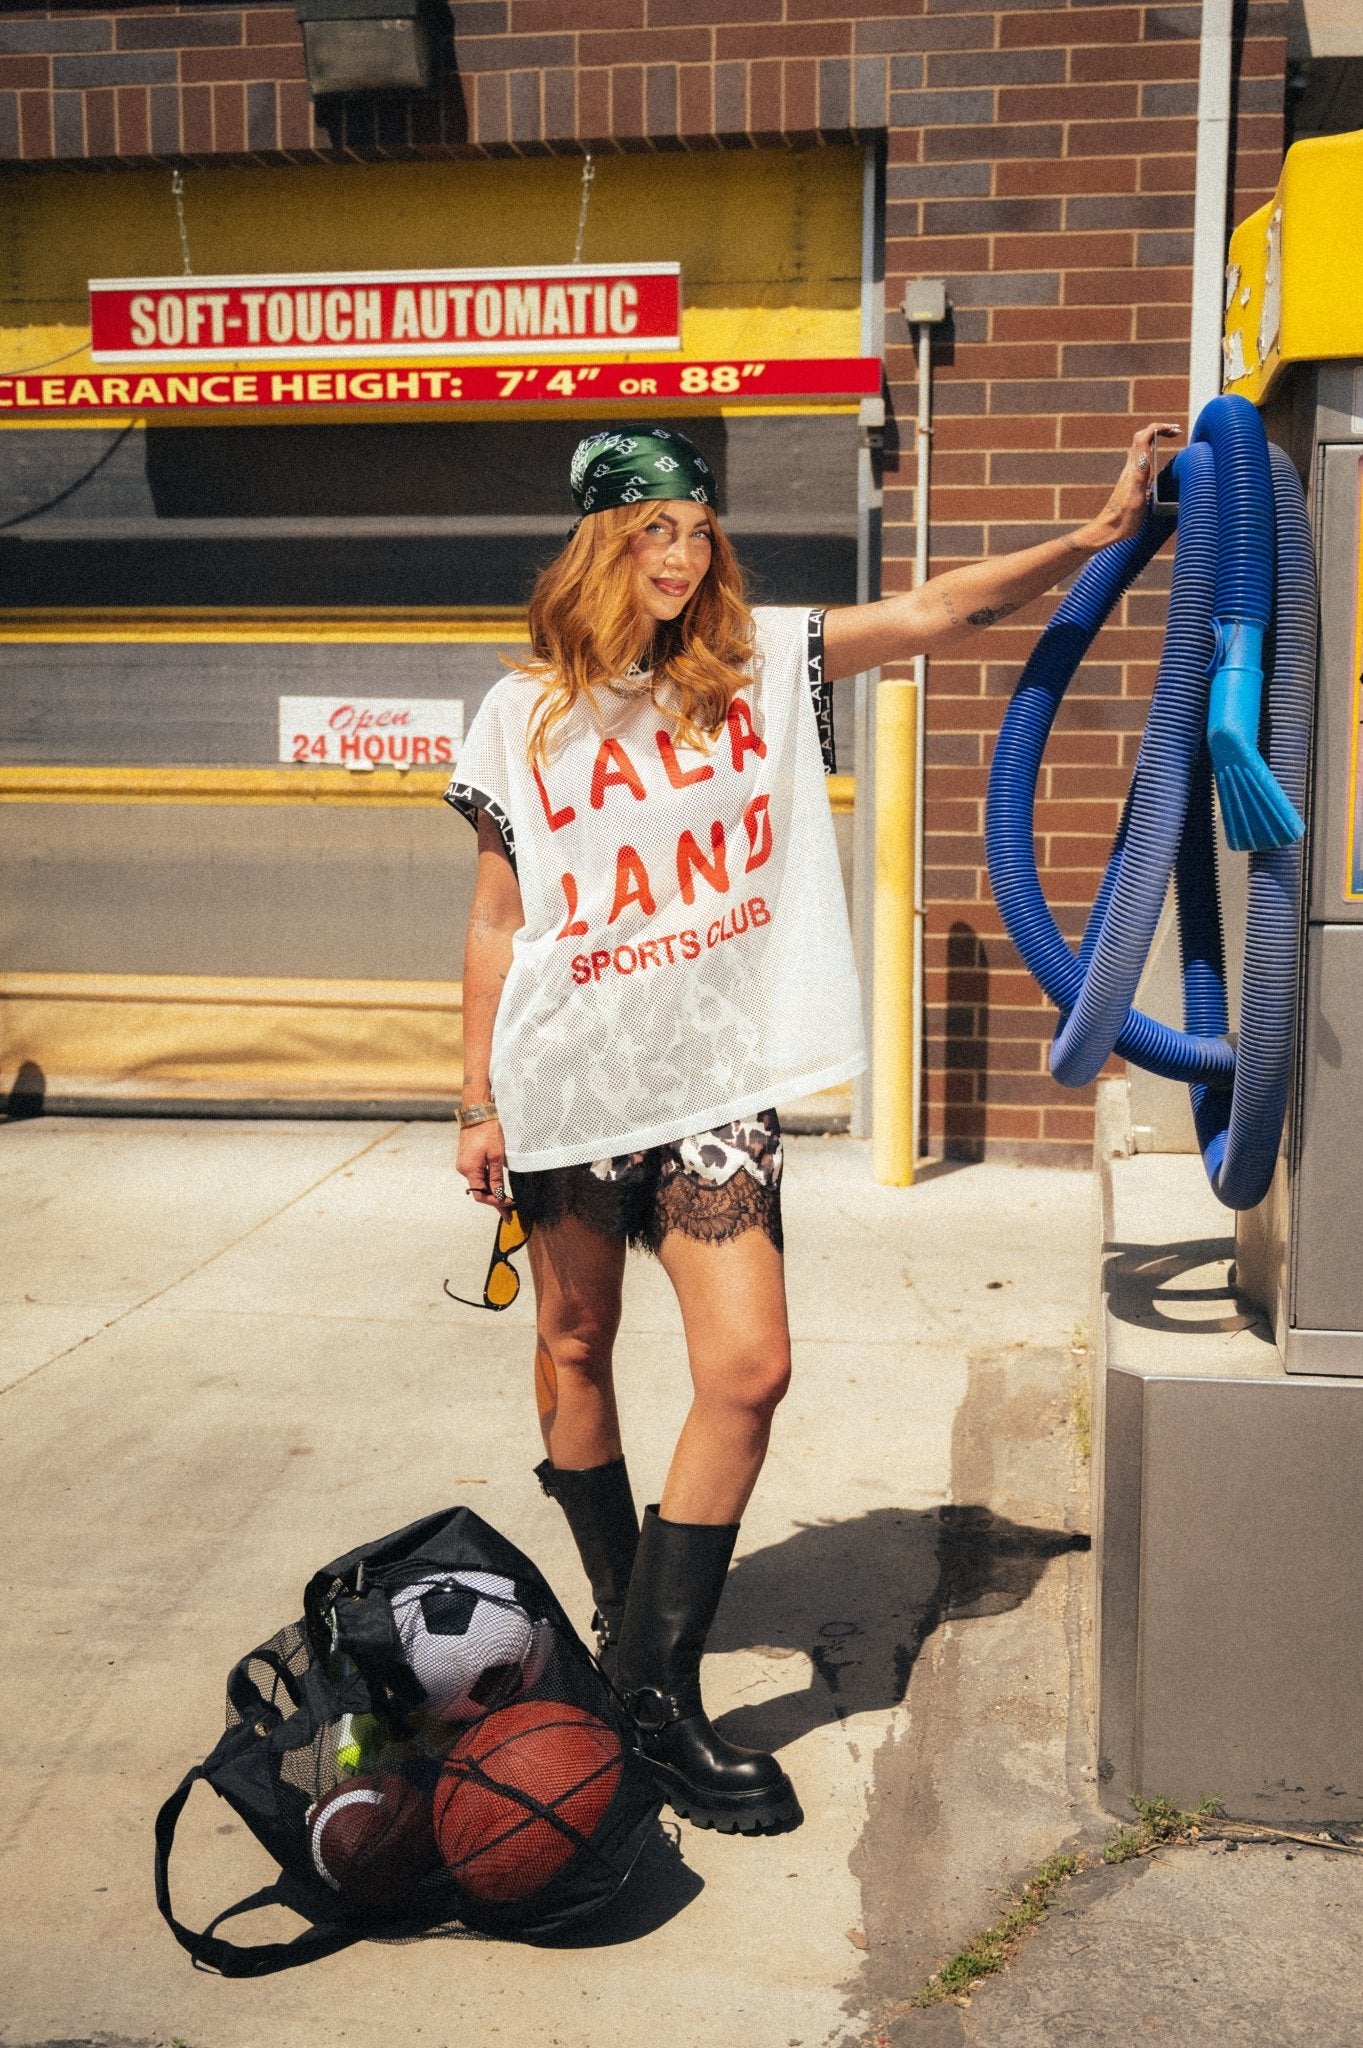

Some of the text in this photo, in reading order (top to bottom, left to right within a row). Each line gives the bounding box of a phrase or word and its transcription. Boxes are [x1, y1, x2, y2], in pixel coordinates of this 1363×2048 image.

[130, 281, 638, 346] SOFT-TOUCH AUTOMATIC
[271, 369, 463, 402] HEIGHT:
[619, 377, 657, 395] OR
[328, 704, 410, 736] Open
[292, 733, 453, 764] 24 HOURS
[555, 794, 773, 941] LAND
[571, 896, 772, 985] SPORTS CLUB
